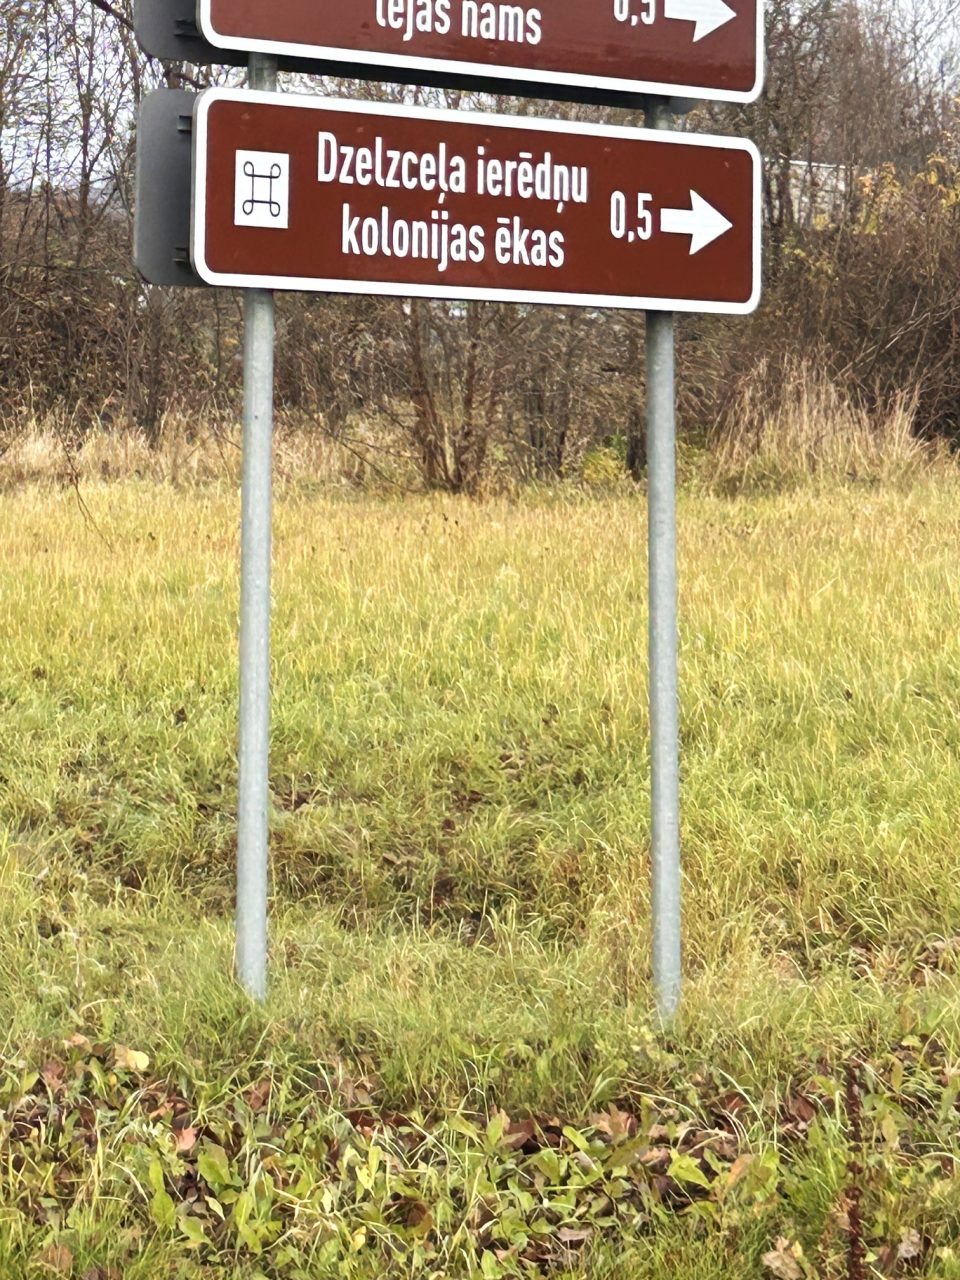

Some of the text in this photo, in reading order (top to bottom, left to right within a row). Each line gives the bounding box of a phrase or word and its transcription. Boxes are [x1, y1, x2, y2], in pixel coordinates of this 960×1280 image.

[317, 131, 588, 213] Dzelzceļa ierēdņu
[341, 204, 565, 272] kolonijas ēkas
[609, 190, 653, 243] 0,5
